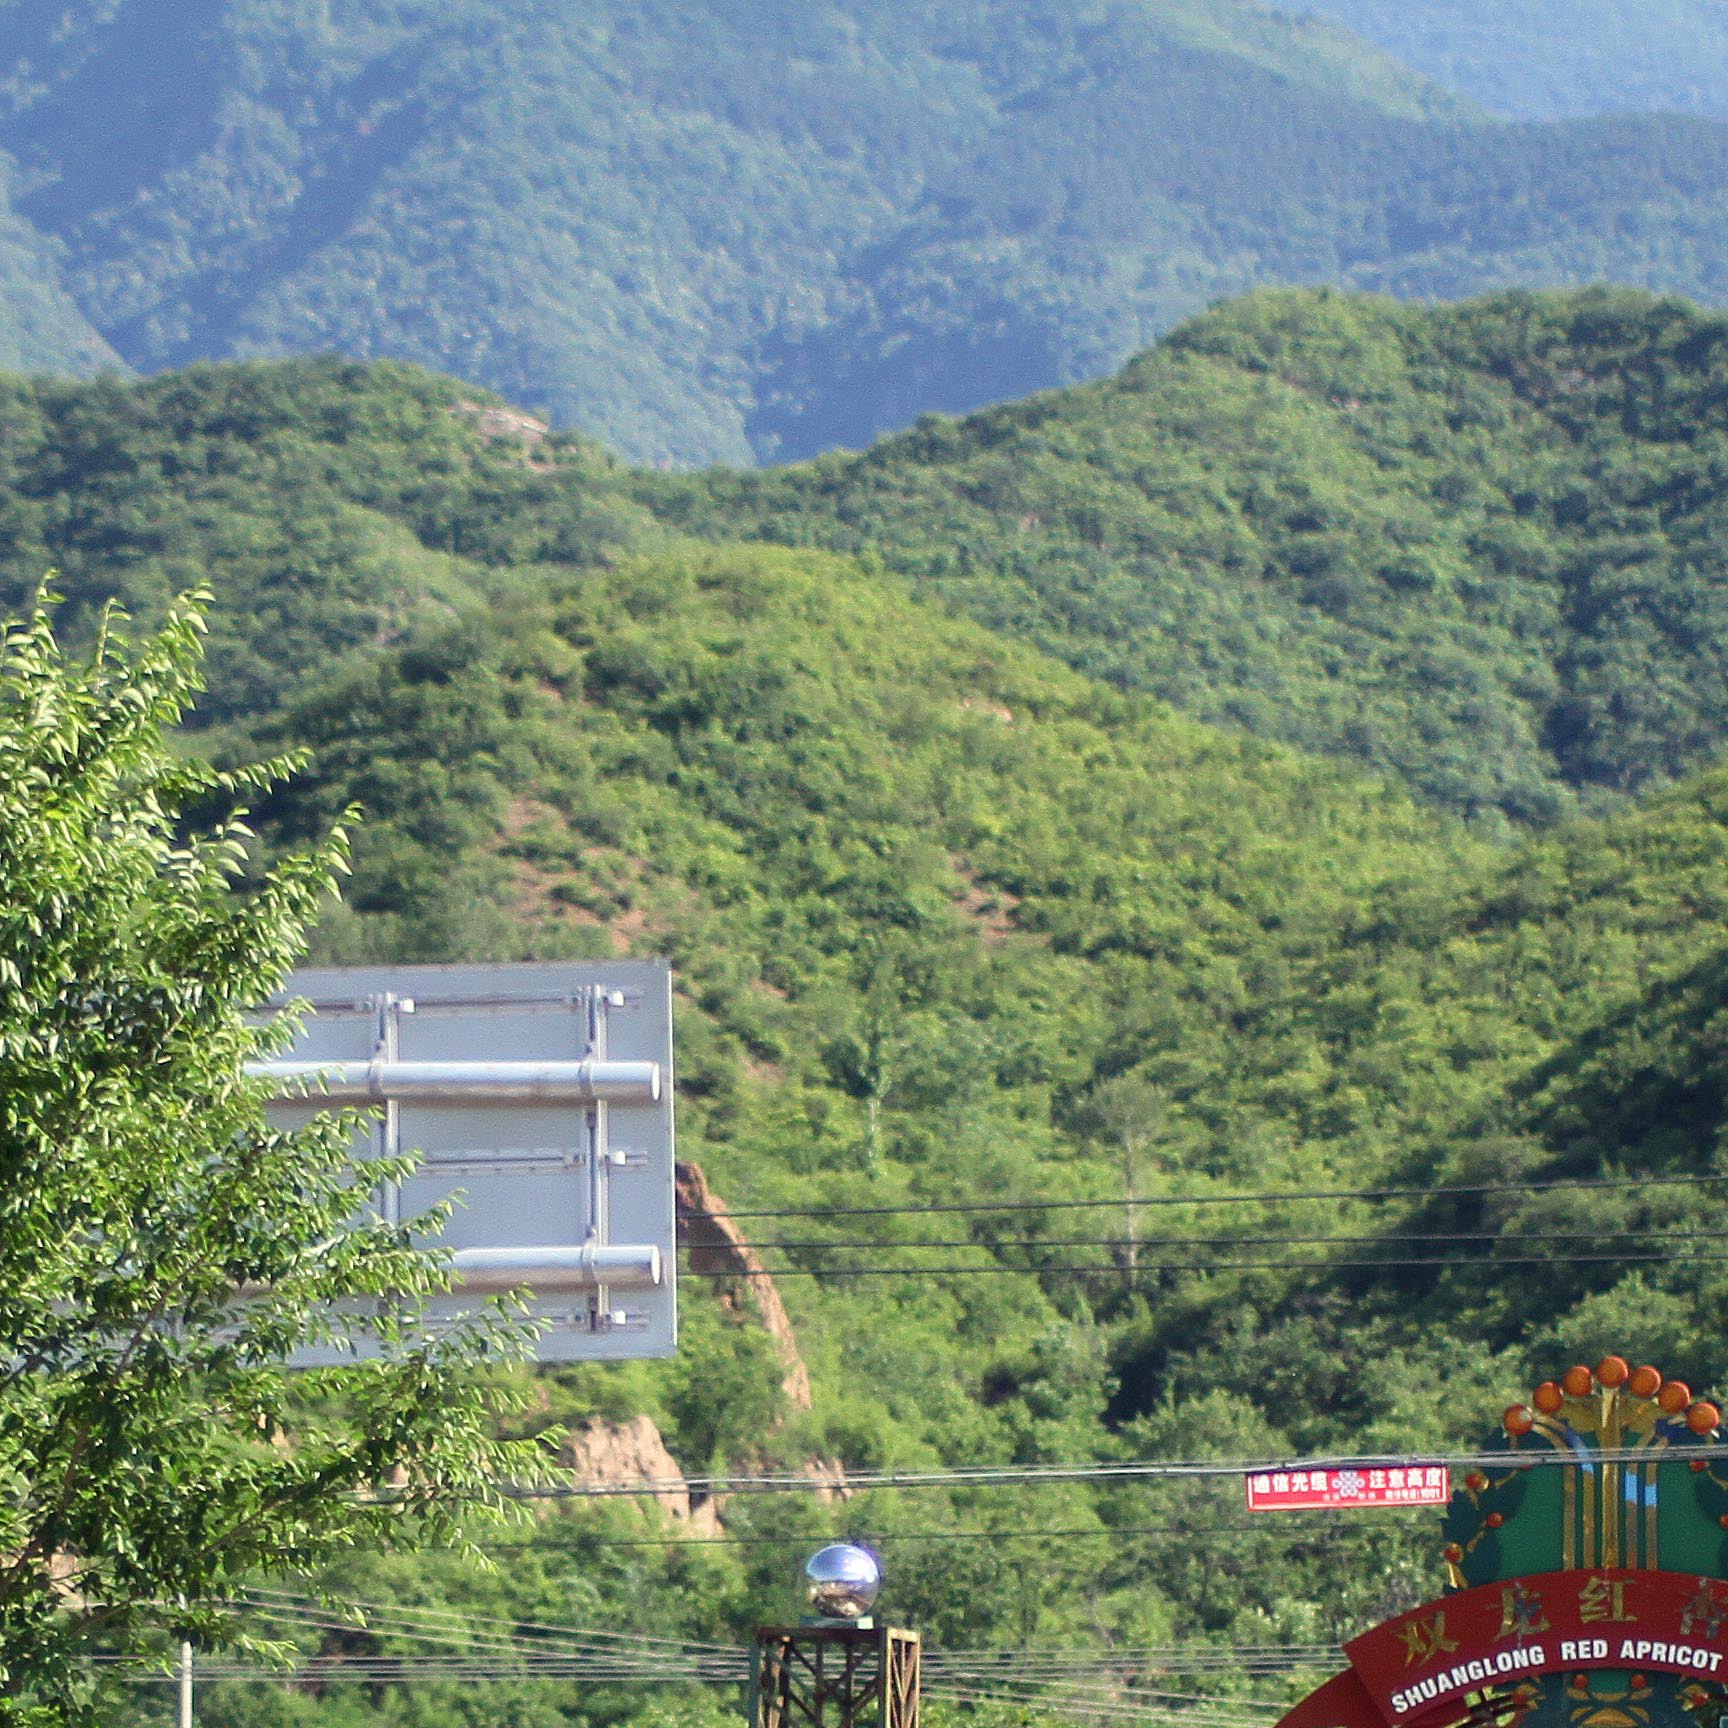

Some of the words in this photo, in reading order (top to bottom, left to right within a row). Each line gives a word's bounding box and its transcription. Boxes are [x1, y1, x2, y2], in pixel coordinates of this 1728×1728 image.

[1390, 1643, 1546, 1716] SHUANGLONG
[1560, 1639, 1609, 1662] RED
[1619, 1639, 1723, 1673] APRICOT
